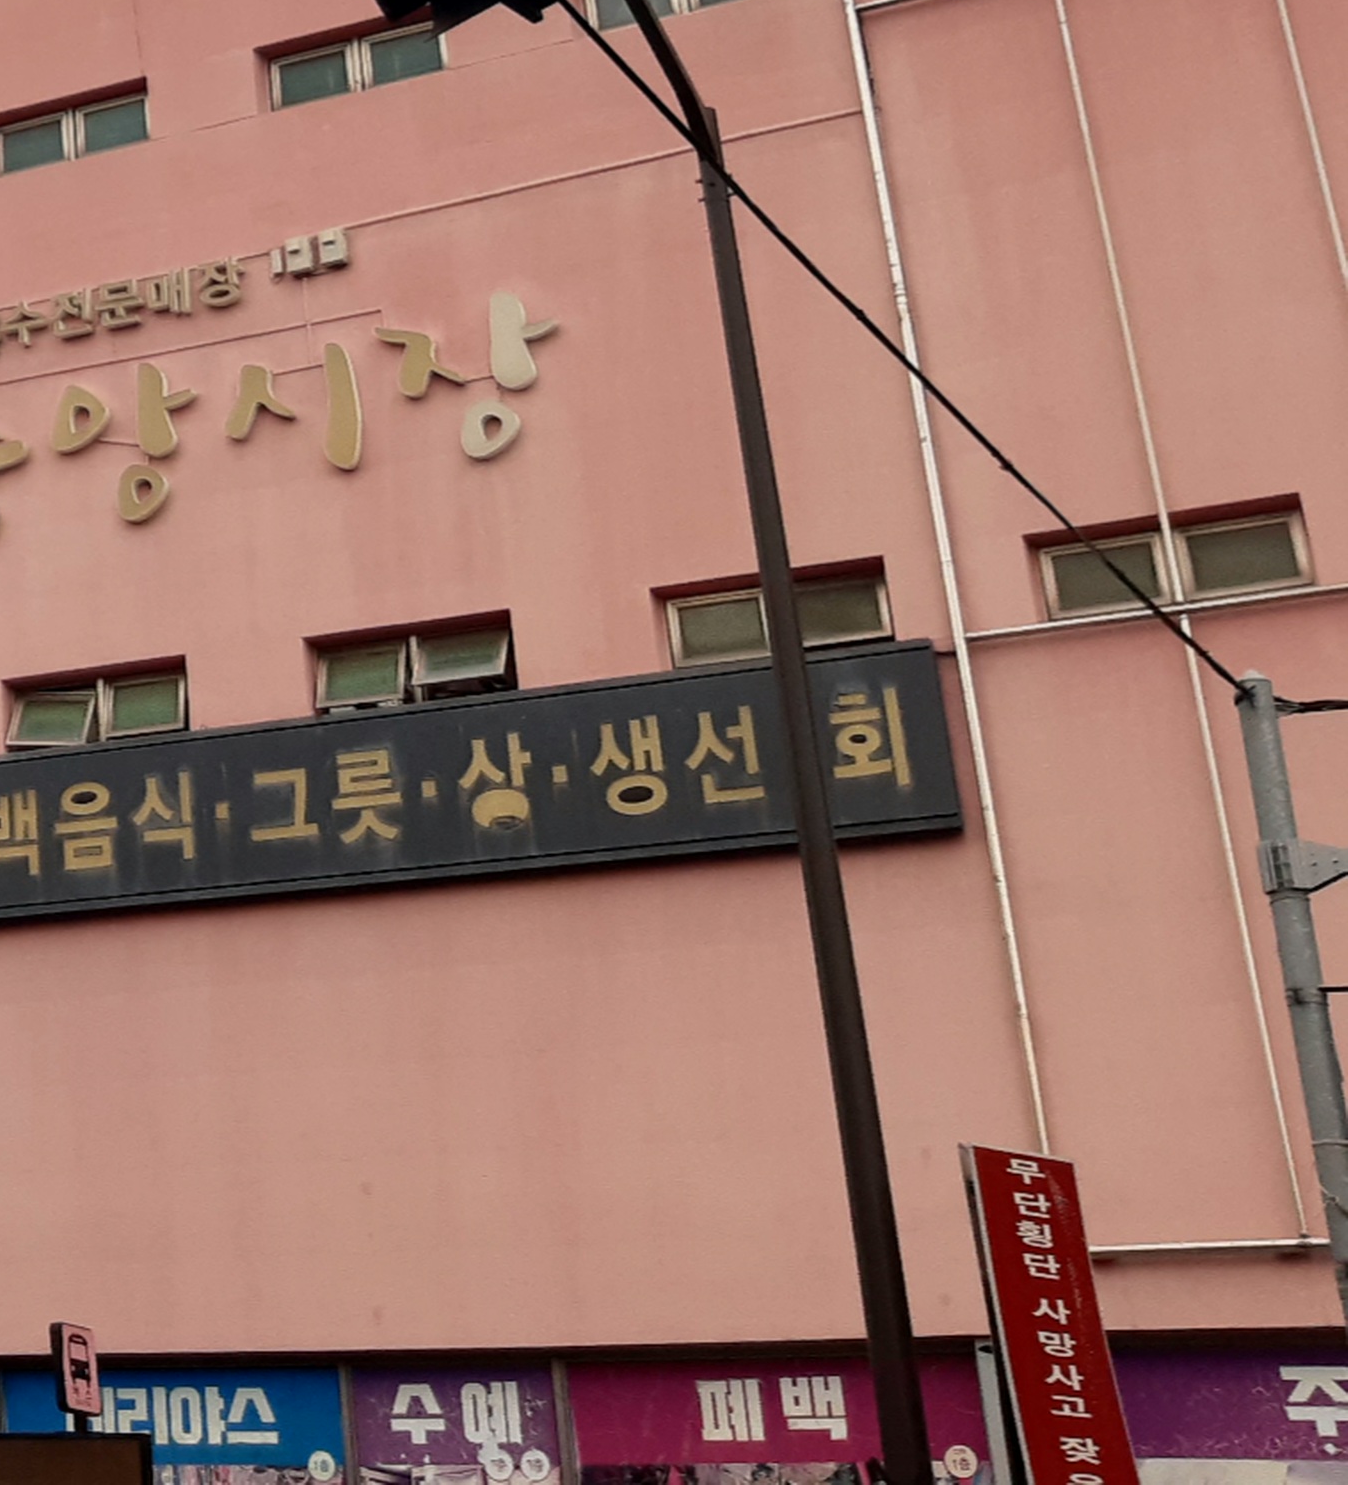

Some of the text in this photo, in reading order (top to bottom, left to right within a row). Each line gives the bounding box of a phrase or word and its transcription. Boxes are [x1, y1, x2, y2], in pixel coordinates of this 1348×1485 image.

[1005, 1157, 1062, 1283] 무단횡단
[1032, 1297, 1094, 1420] 사망사고
[389, 1381, 524, 1446] 수예
[695, 1376, 848, 1442] 폐백
